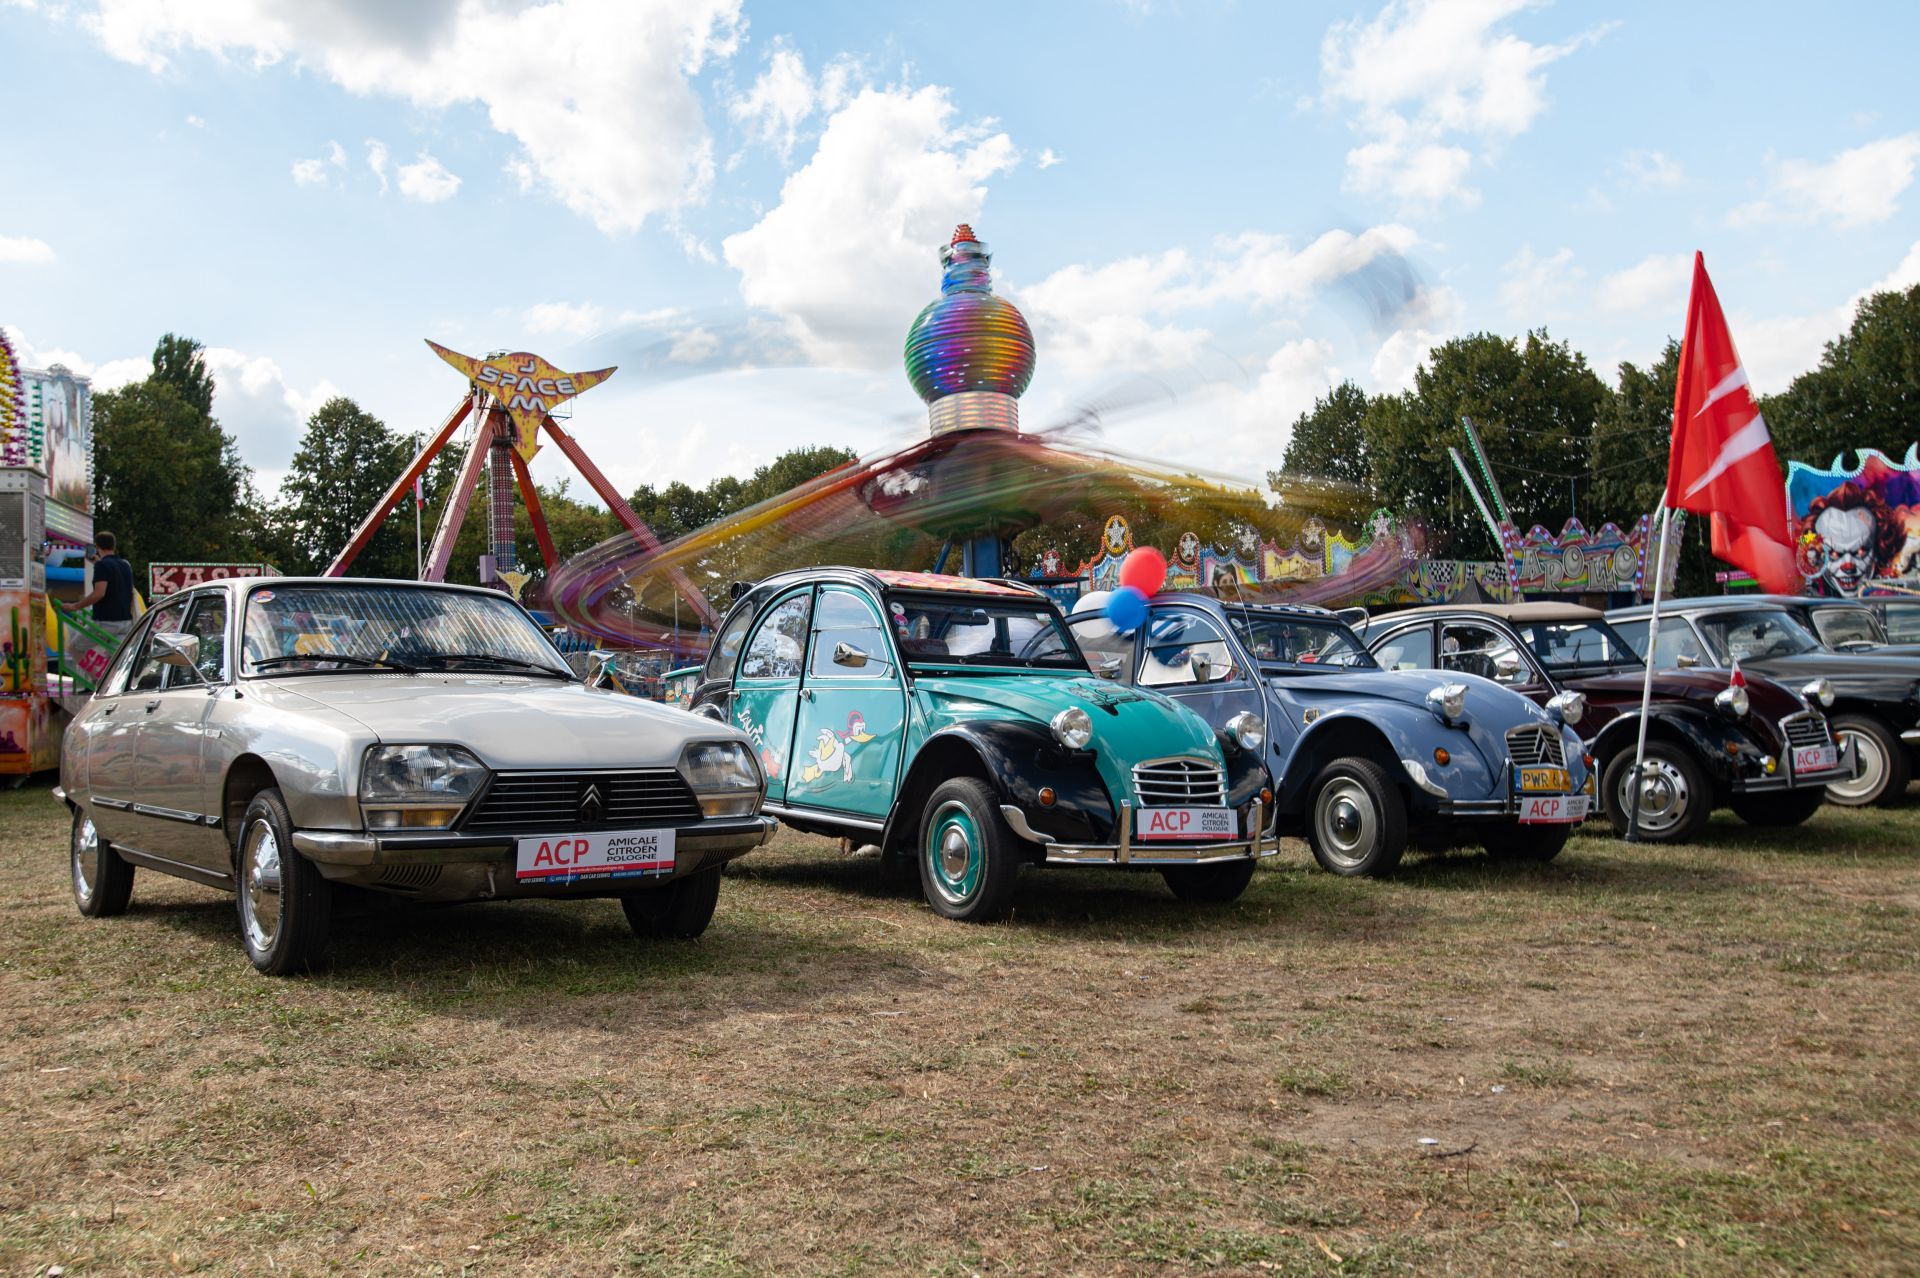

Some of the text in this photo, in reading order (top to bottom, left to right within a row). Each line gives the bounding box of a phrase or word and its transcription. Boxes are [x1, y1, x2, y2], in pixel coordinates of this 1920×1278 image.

[477, 364, 576, 396] SPACE
[1519, 544, 1637, 592] APOLLO
[1796, 751, 1820, 767] ACP
[1523, 772, 1548, 788] PWR
[1530, 799, 1560, 817] ACP
[1150, 811, 1190, 831] ACP
[608, 836, 658, 847] AMICALE
[533, 839, 590, 867] ACP
[606, 853, 657, 863] POLOGNE
